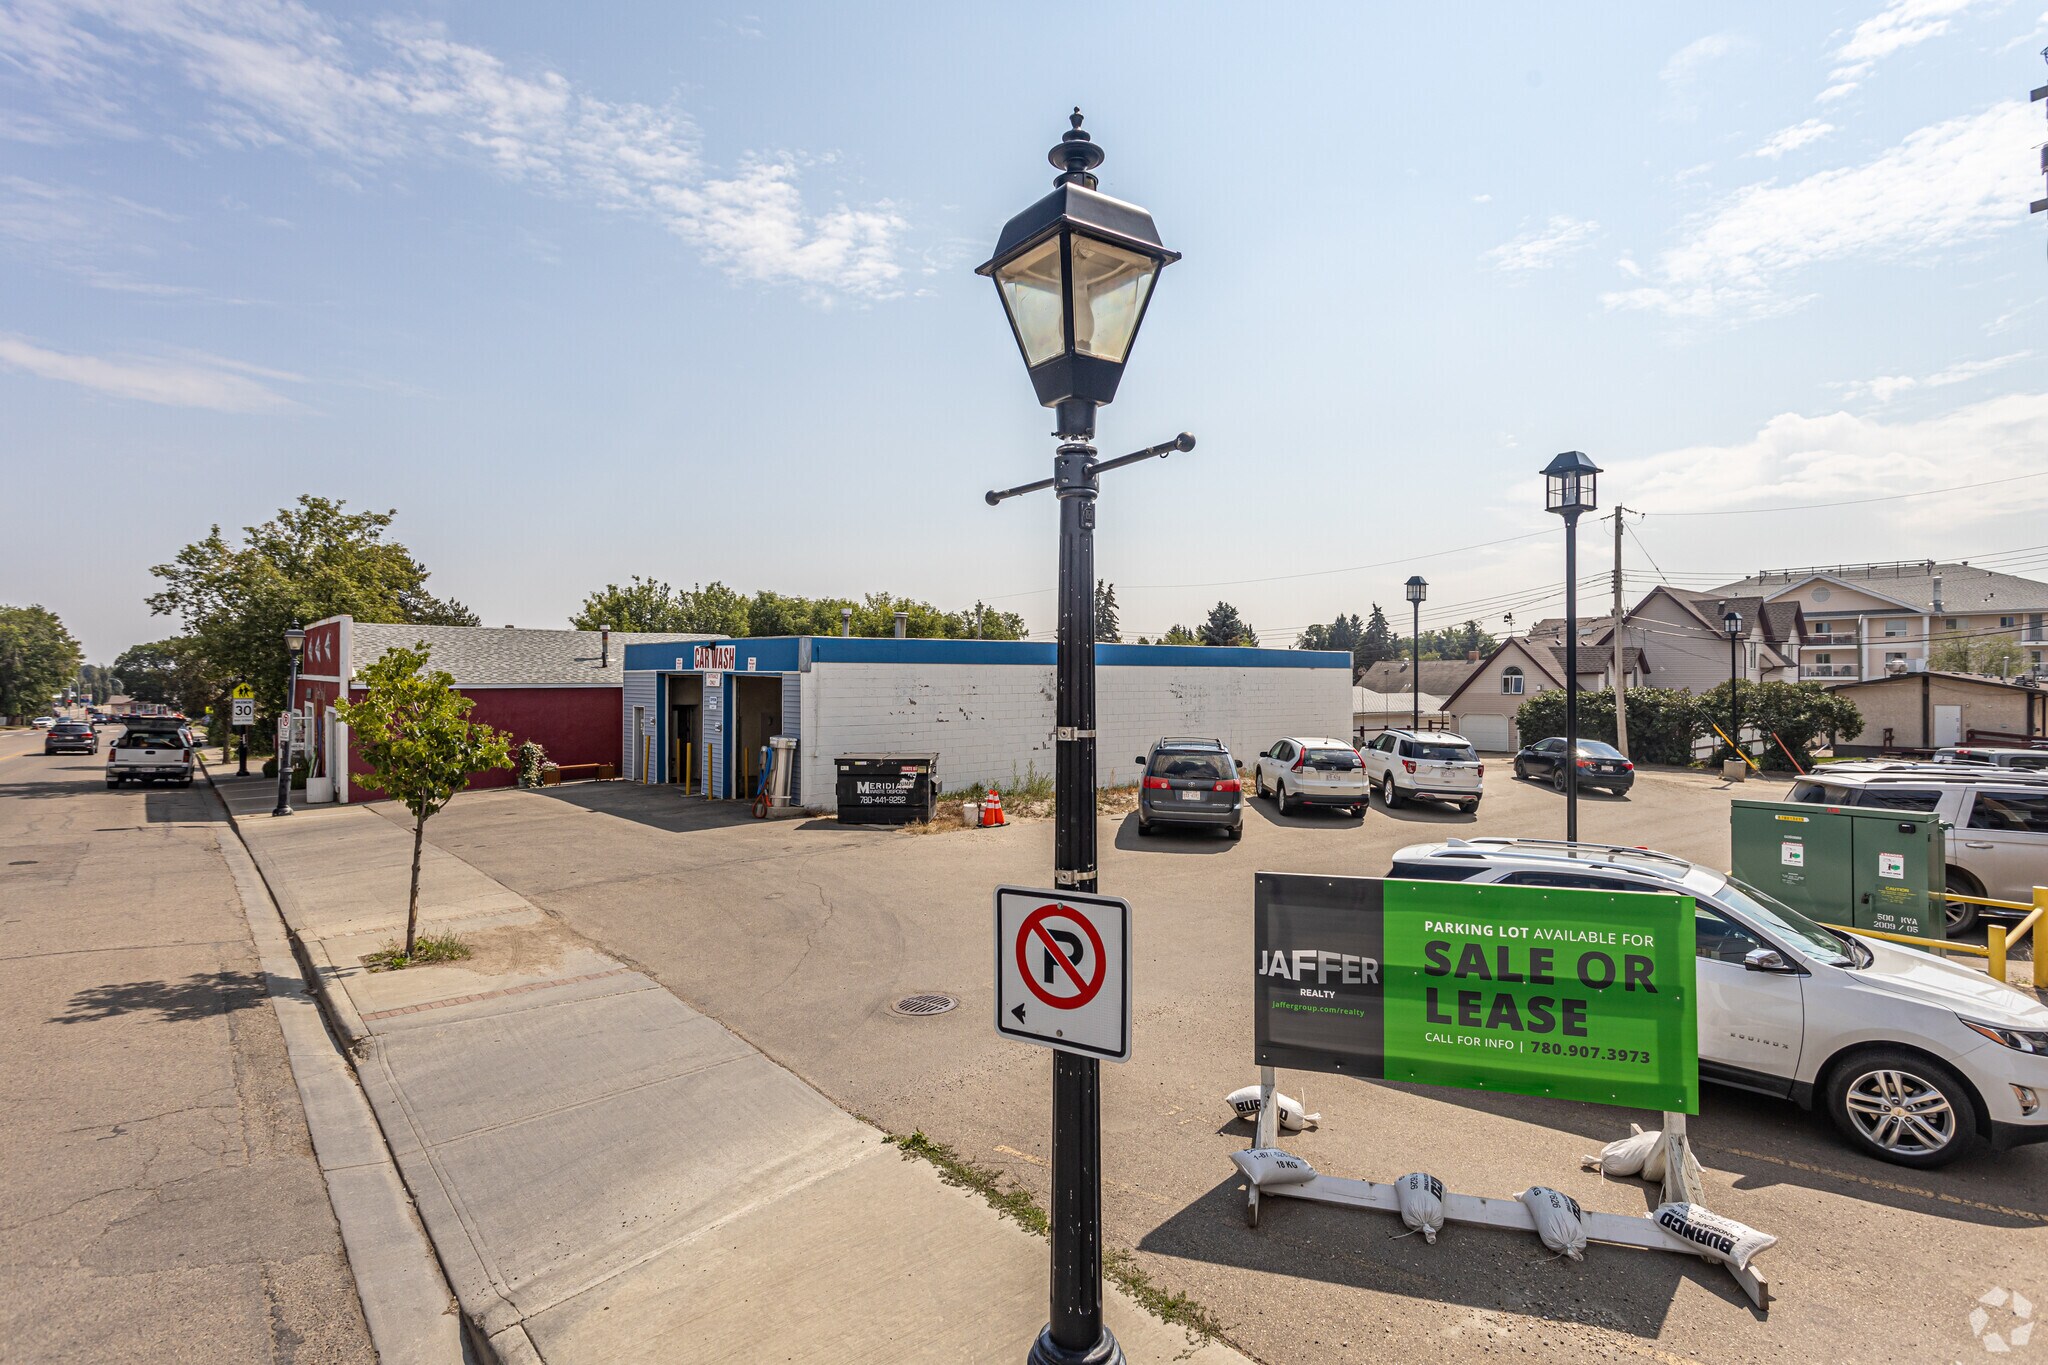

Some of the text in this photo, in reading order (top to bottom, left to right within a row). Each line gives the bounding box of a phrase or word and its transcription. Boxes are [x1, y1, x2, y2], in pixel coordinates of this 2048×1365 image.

[694, 647, 710, 669] CAR
[712, 647, 735, 669] WASH
[235, 705, 252, 716] 30
[857, 781, 903, 794] MERIDIA
[860, 796, 906, 804] 780-441-9252
[1873, 921, 1896, 930] 2009
[1906, 925, 1919, 933] 05
[1877, 913, 1918, 926] 500 KVA
[1425, 920, 1654, 948] PARKING LOT AVAILABLE FOR
[1258, 949, 1379, 985] JAFFER
[1424, 940, 1658, 993] SALE OR
[1300, 988, 1336, 999] REALTY
[1426, 986, 1588, 1037] LEASE
[1425, 1032, 1453, 1044] CALL
[1457, 1035, 1481, 1047] FOR
[1485, 1038, 1514, 1050] INFO
[1531, 1041, 1650, 1064] 780.907.3973
[1730, 1032, 1789, 1050] EQUINOX
[1236, 1100, 1289, 1121] BURO
[1276, 1161, 1298, 1169] 18 KG
[1660, 1212, 1737, 1256] BURNCO
[1694, 1220, 1741, 1242] LANDSCAPE
